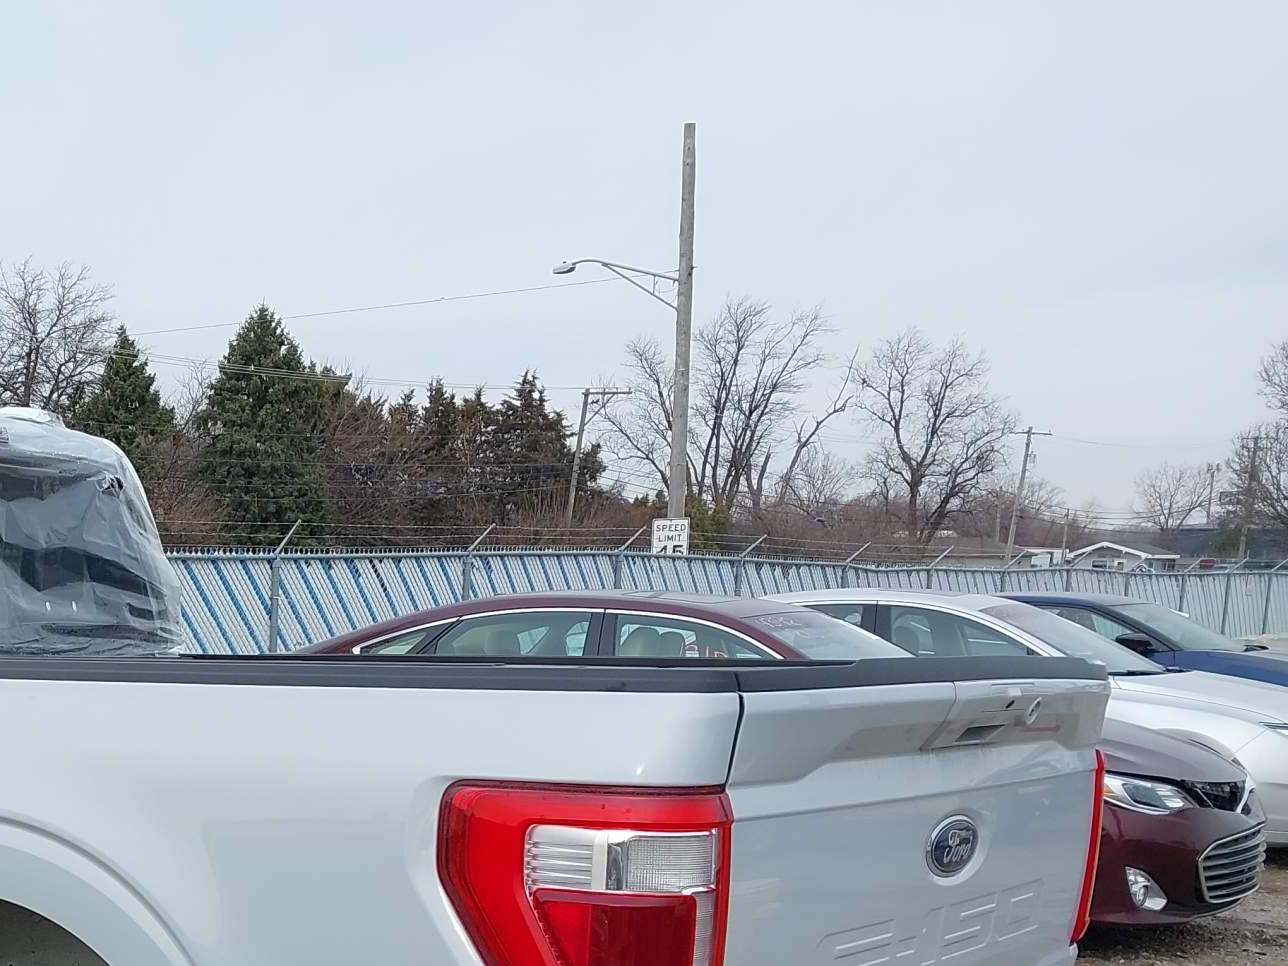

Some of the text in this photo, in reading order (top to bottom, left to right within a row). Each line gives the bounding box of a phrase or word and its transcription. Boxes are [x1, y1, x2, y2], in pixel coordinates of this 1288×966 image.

[655, 524, 686, 532] SPEED
[658, 534, 682, 542] LIMIT
[943, 829, 974, 864] Ford
